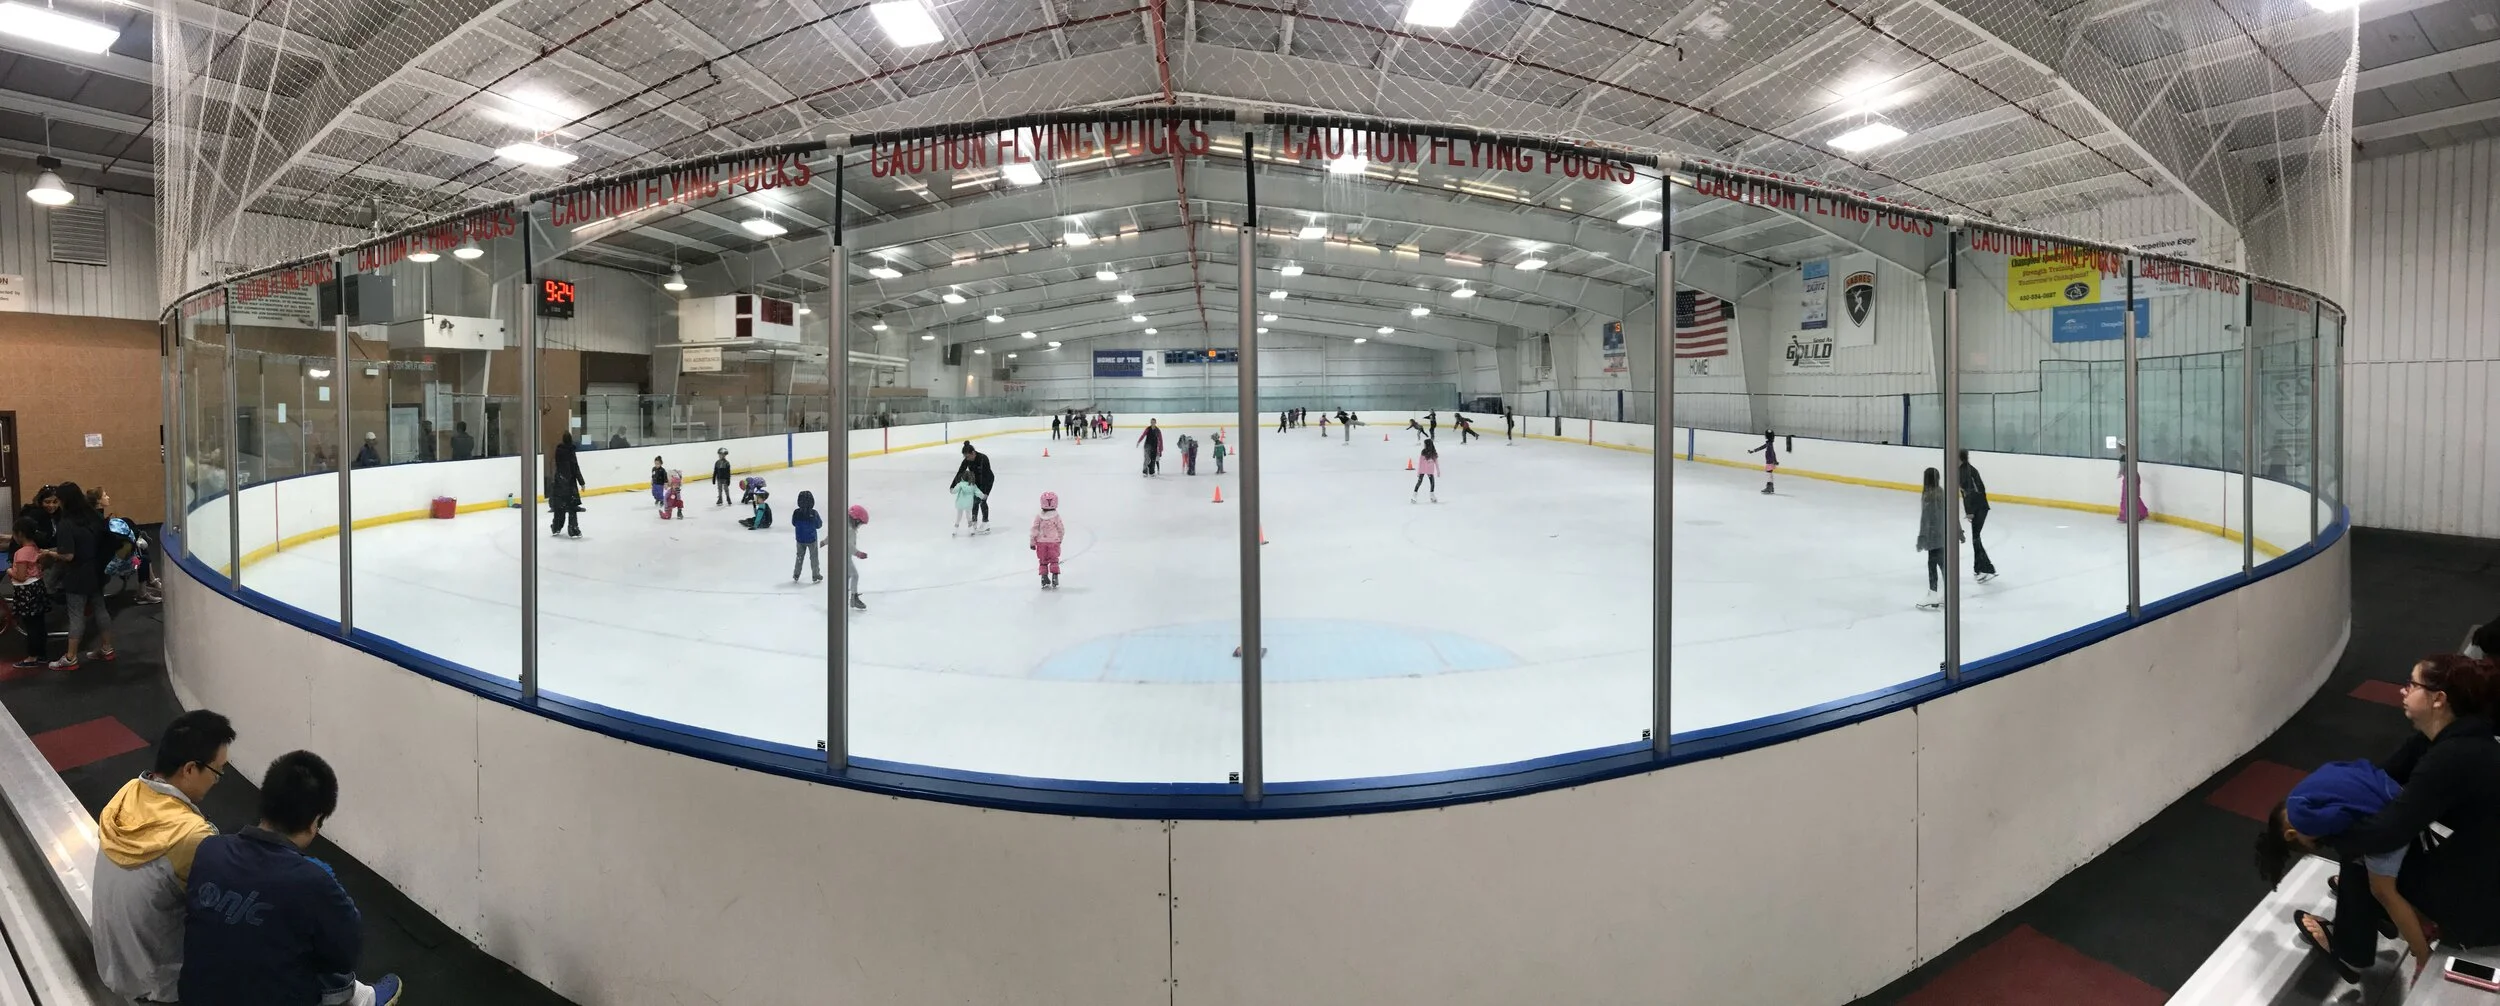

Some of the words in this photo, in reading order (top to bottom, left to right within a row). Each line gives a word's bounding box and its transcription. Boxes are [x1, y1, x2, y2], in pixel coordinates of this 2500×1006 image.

[871, 132, 986, 178] CAUTION
[997, 122, 1093, 166] FLYING
[1104, 118, 1210, 157] PUCKS
[1283, 125, 1417, 163] CAUTION
[1430, 132, 1534, 173] FLYING
[1545, 143, 1636, 185] PUCKS
[551, 182, 638, 227] CAUTION
[646, 163, 720, 208] FLYING
[728, 151, 810, 194] PUCKS
[1696, 160, 1796, 211] CAUTION
[1803, 177, 1869, 224] FLYING
[1875, 196, 1934, 238] PUCKS
[358, 234, 407, 272] CAUTION
[412, 222, 460, 256] FLYING
[463, 205, 516, 244] PUCKS
[1971, 228, 2033, 259] CAUTION
[2038, 237, 2079, 267] FLYING
[2083, 246, 2119, 276] PUCKS
[237, 277, 269, 304] CAUTION
[271, 267, 300, 295] FLYING
[301, 258, 333, 287] PUCKS
[545, 280, 575, 303] 9:24
[1847, 274, 1872, 288] SABRES
[2140, 254, 2181, 284] CAUTION
[2183, 265, 2213, 291] FLYING
[2214, 273, 2240, 296] PUCKS
[1786, 343, 1833, 360] GOULD
